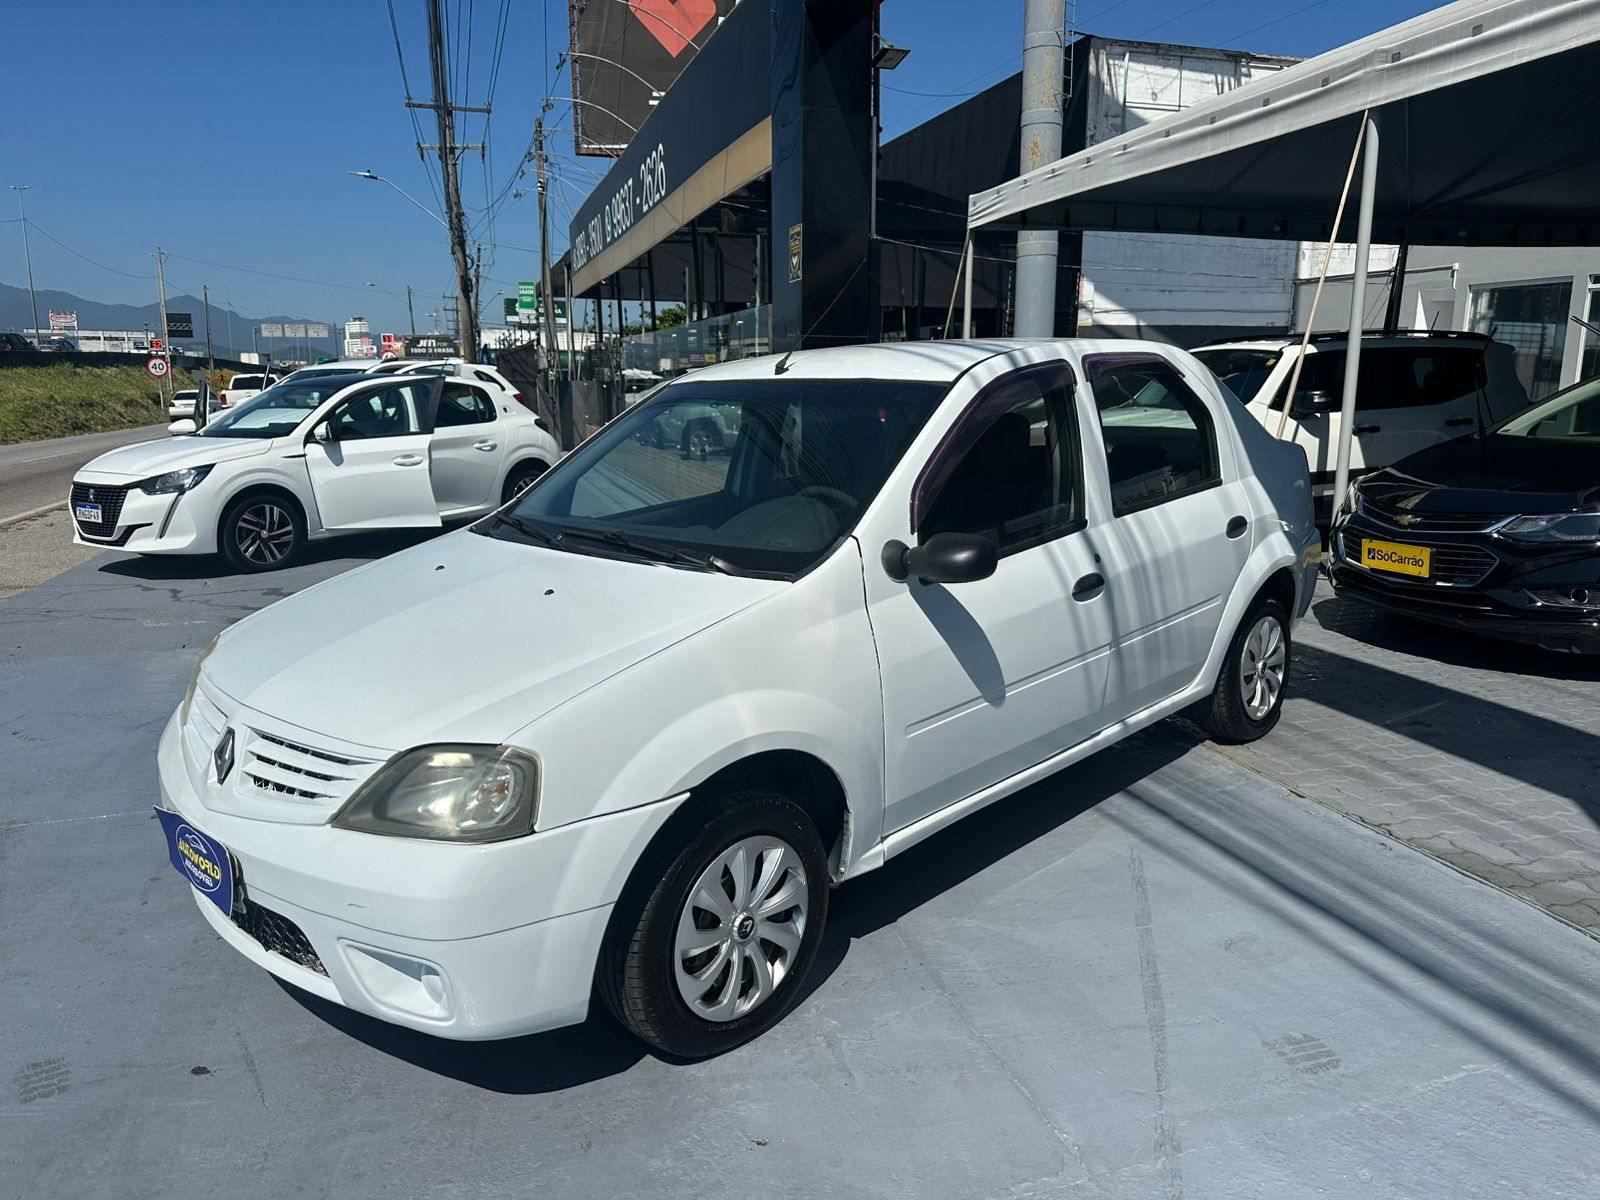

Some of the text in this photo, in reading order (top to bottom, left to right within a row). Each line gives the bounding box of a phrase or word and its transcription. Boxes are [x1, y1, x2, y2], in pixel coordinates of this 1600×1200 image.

[612, 177, 634, 238] 99637
[641, 143, 666, 213] 2626
[151, 362, 165, 371] 40
[178, 837, 220, 880] AUTOWORLD
